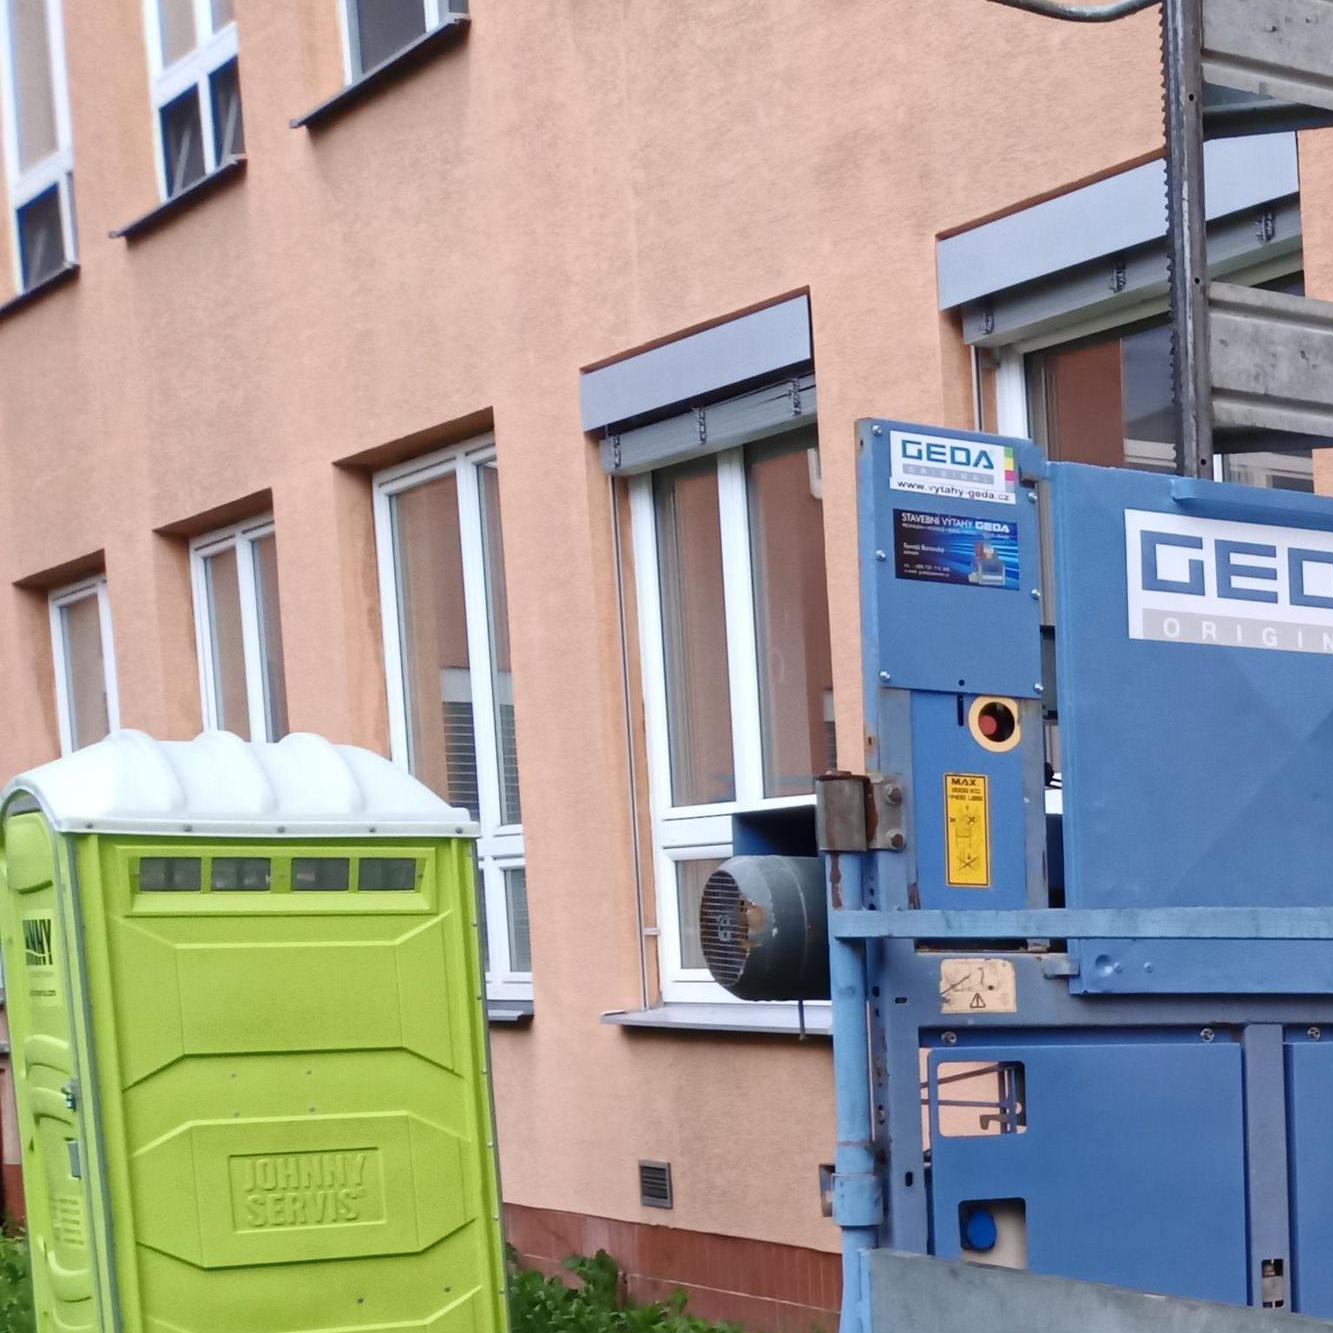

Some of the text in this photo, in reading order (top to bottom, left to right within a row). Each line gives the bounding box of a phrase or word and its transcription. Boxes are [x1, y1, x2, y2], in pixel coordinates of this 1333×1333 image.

[902, 440, 994, 469] GEDA
[975, 521, 1010, 533] GEDA
[951, 778, 976, 786] MAX
[245, 1153, 366, 1192] JOHNNY
[248, 1188, 358, 1227] SERVIS
